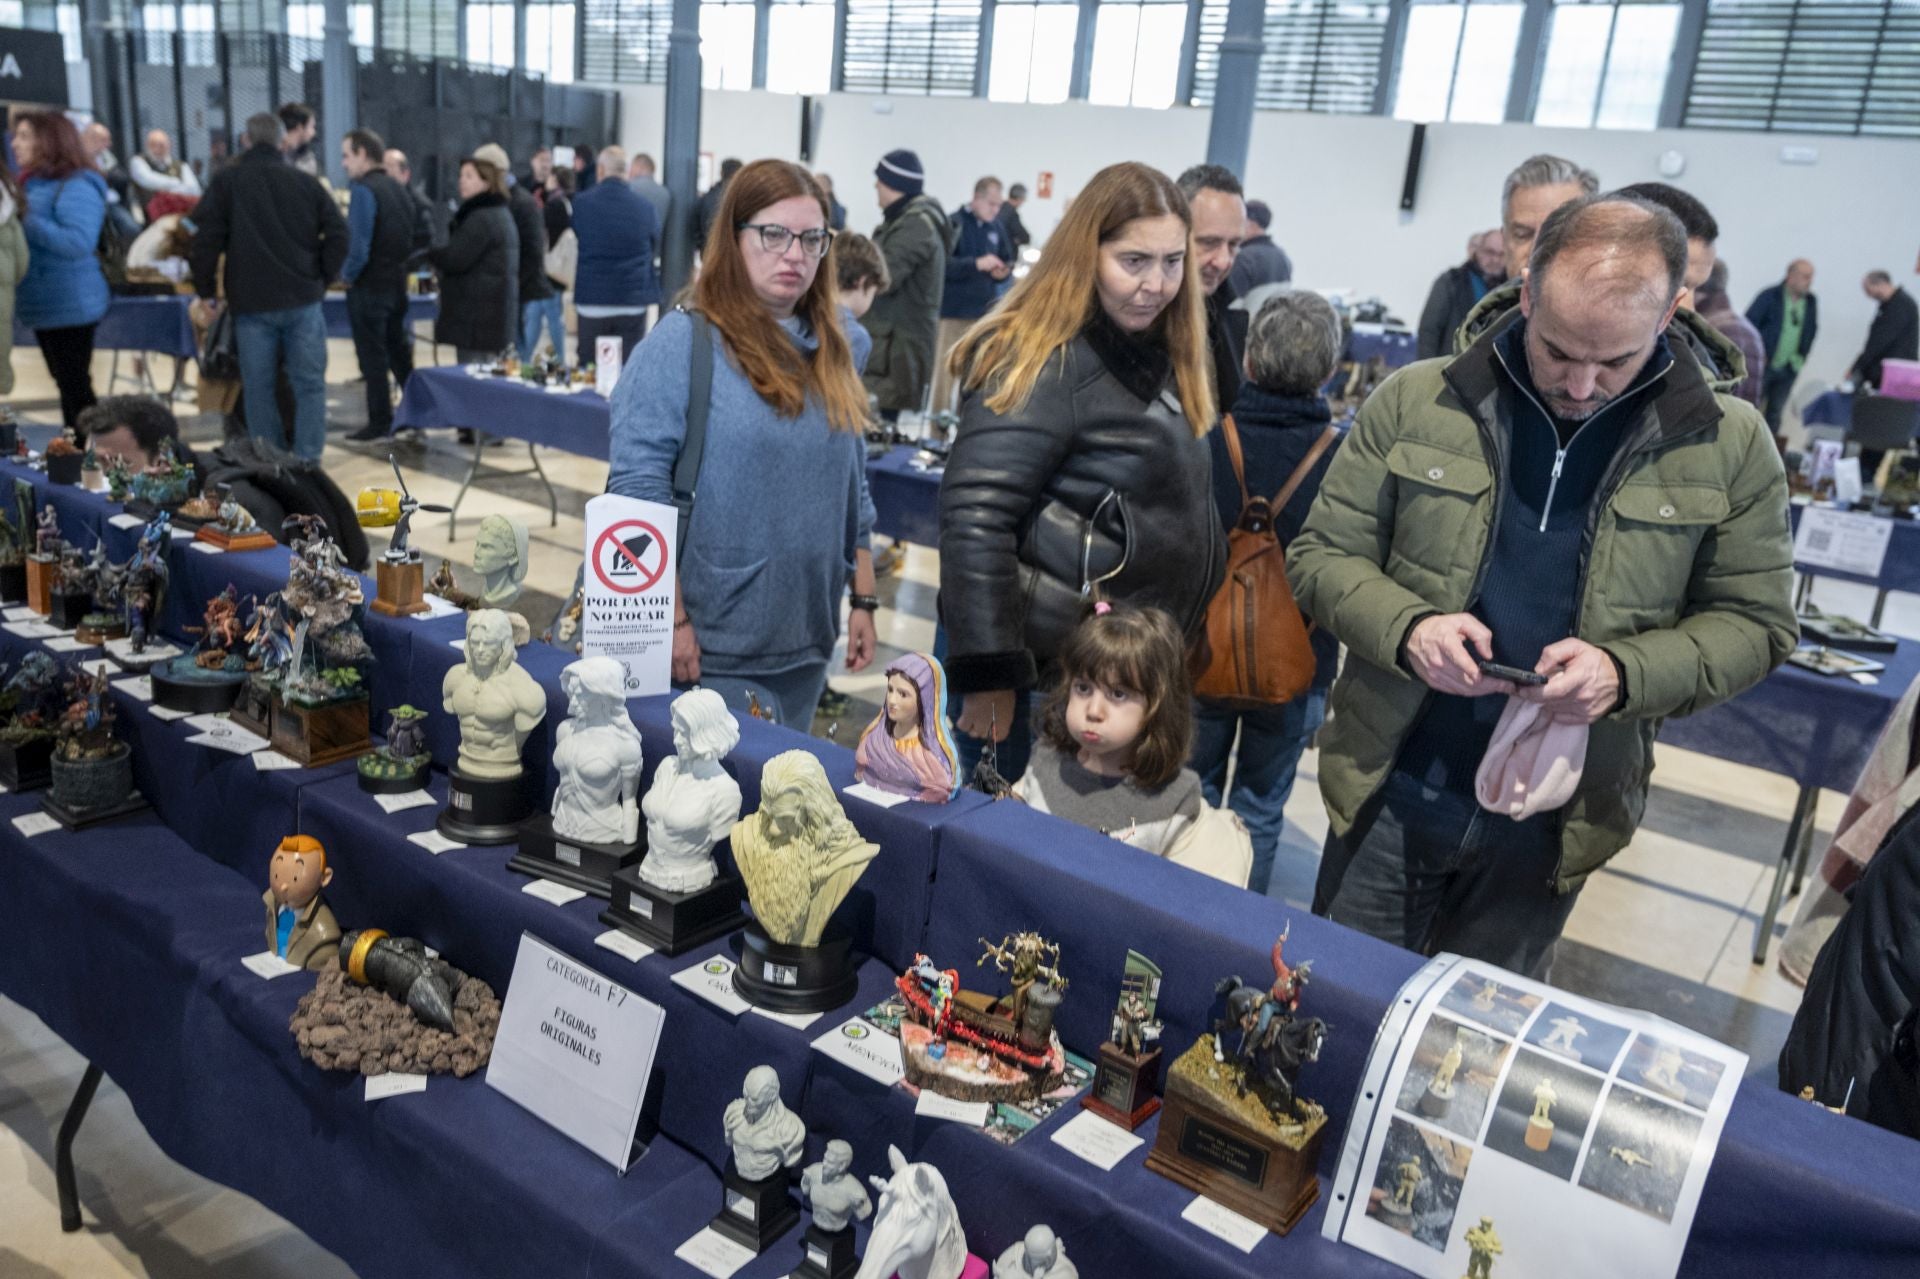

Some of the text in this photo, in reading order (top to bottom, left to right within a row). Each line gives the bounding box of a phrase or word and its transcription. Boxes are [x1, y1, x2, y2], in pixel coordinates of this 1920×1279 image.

[587, 596, 670, 607] POR FAVOR
[591, 610, 665, 622] NO TOCAR
[546, 957, 628, 1008] CATEGORÍA F7
[554, 1006, 598, 1040] FIGURAS
[540, 1020, 601, 1066] ORIGINALES
